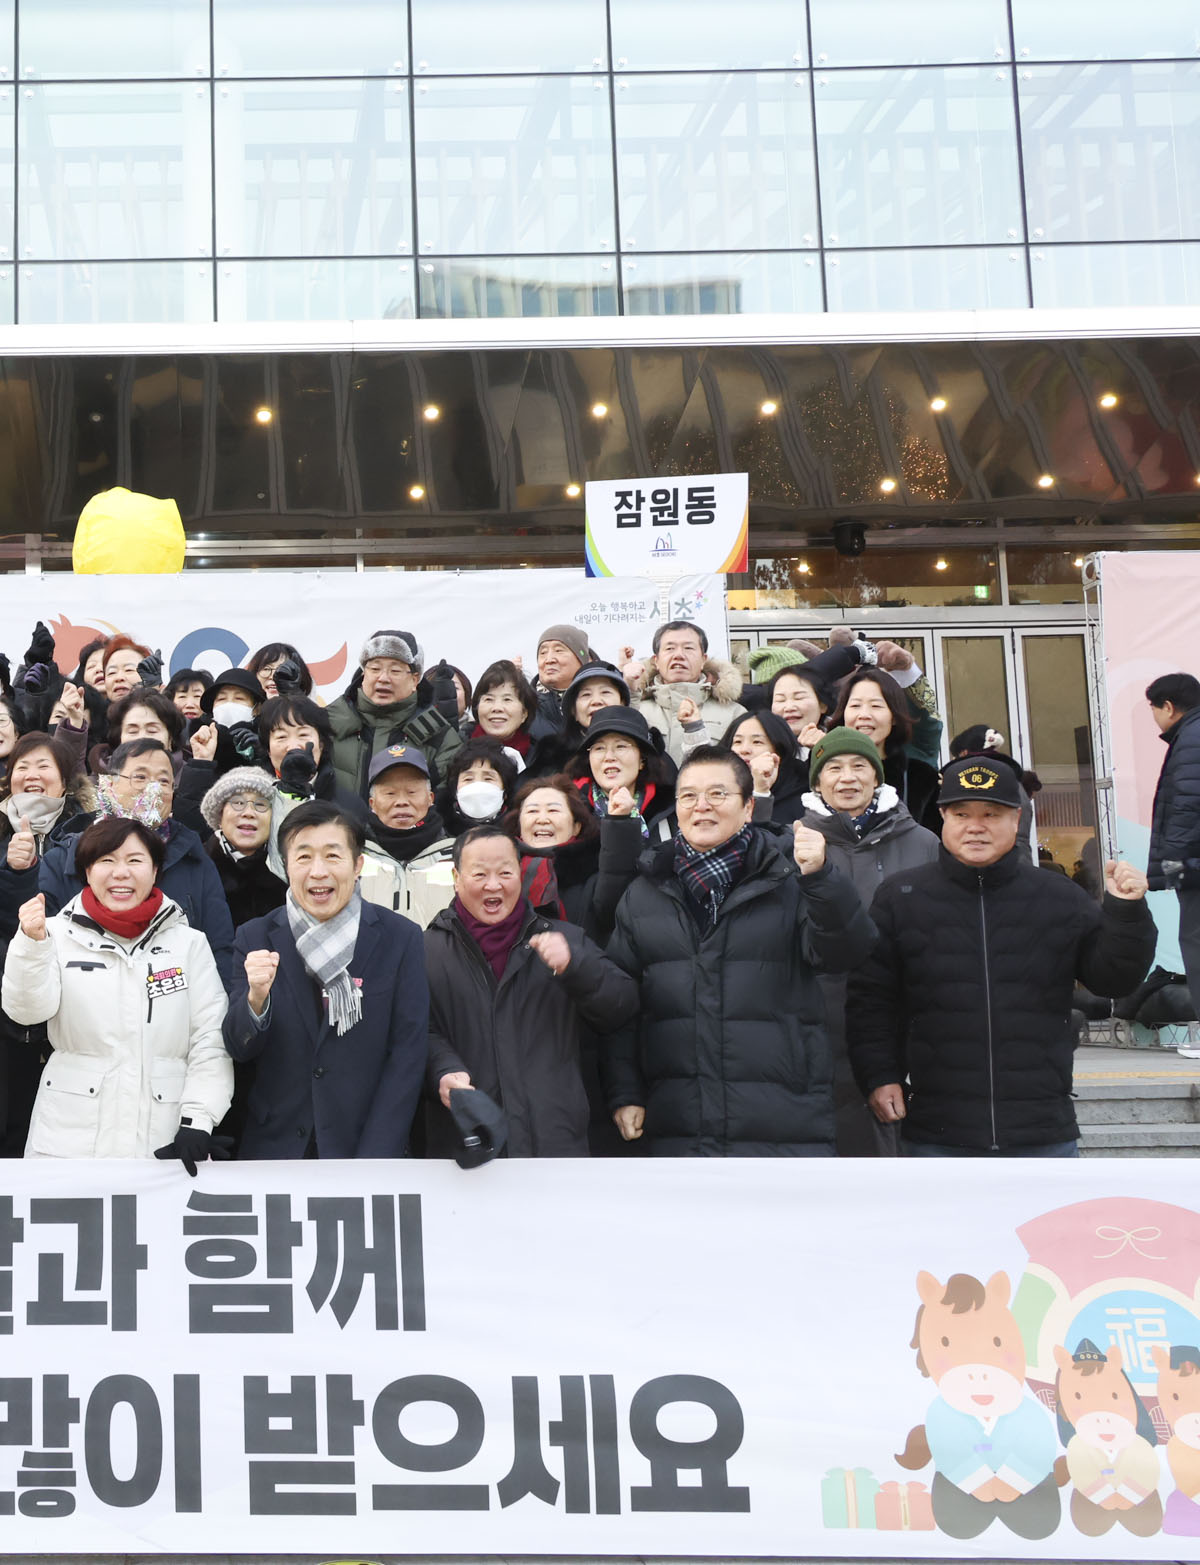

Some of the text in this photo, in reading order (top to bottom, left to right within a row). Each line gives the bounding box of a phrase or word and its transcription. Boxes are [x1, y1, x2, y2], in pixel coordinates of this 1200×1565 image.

[614, 486, 717, 529] 잠원동
[575, 613, 647, 624] 내일이 기다려지는
[590, 601, 646, 612] 오늘 행복하고
[147, 973, 188, 999] 조은희
[183, 1189, 427, 1333] 함께
[1105, 1307, 1171, 1374] 福
[243, 1374, 751, 1515] 받으세요
